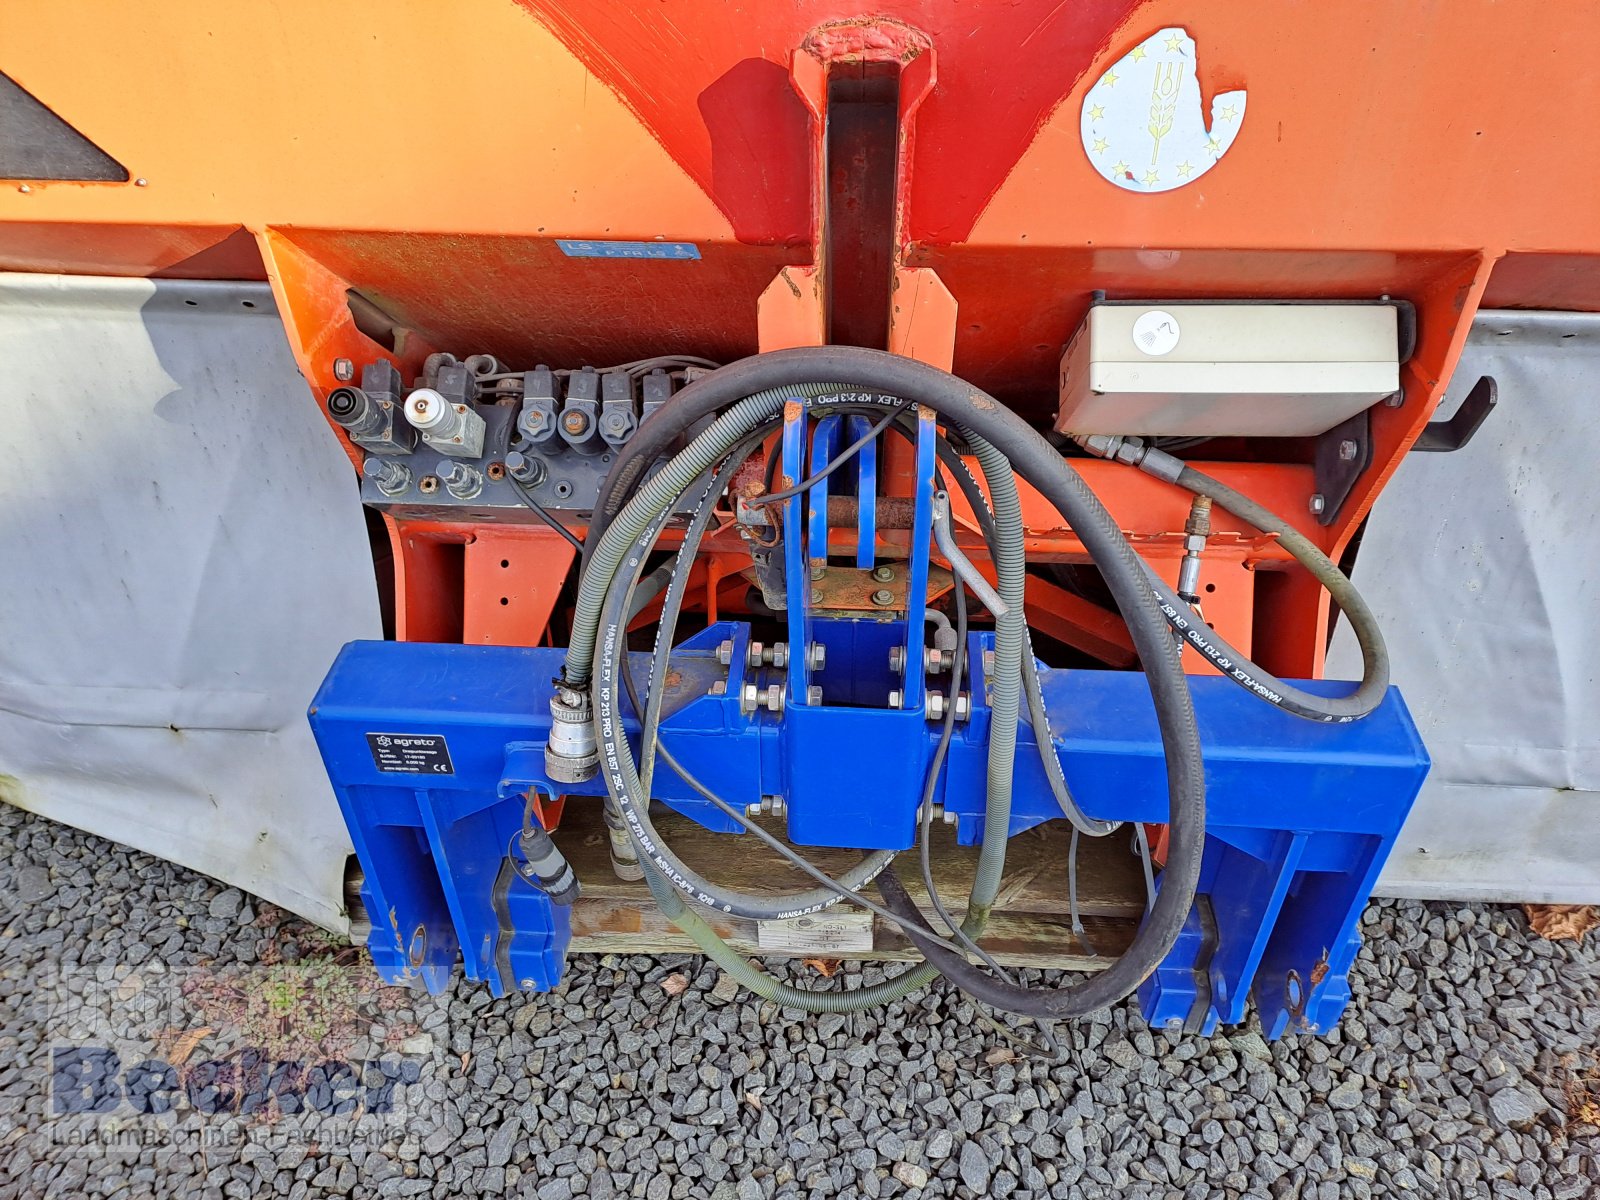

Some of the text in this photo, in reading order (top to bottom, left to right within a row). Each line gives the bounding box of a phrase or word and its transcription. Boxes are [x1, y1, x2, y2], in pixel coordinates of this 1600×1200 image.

[1160, 604, 1176, 617] 857
[1172, 615, 1188, 629] EN
[1188, 630, 1208, 648] PRO
[601, 624, 617, 682] HANSA-FLEX
[1204, 645, 1221, 659] 213
[1216, 658, 1232, 669] KP
[1231, 668, 1283, 704] HANSA-FLEX
[601, 687, 610, 701] KP
[601, 702, 610, 717] 213
[602, 718, 613, 738] PRO
[394, 738, 434, 747] agreto
[604, 742, 615, 756] EN
[608, 756, 619, 771] 857
[612, 773, 624, 791] 2SC
[620, 795, 629, 806] 12
[625, 809, 637, 824] WP
[632, 823, 646, 838] 275
[640, 836, 656, 854] BAR
[654, 855, 674, 878] MSHA
[777, 903, 823, 919] HANSA-FLEX
